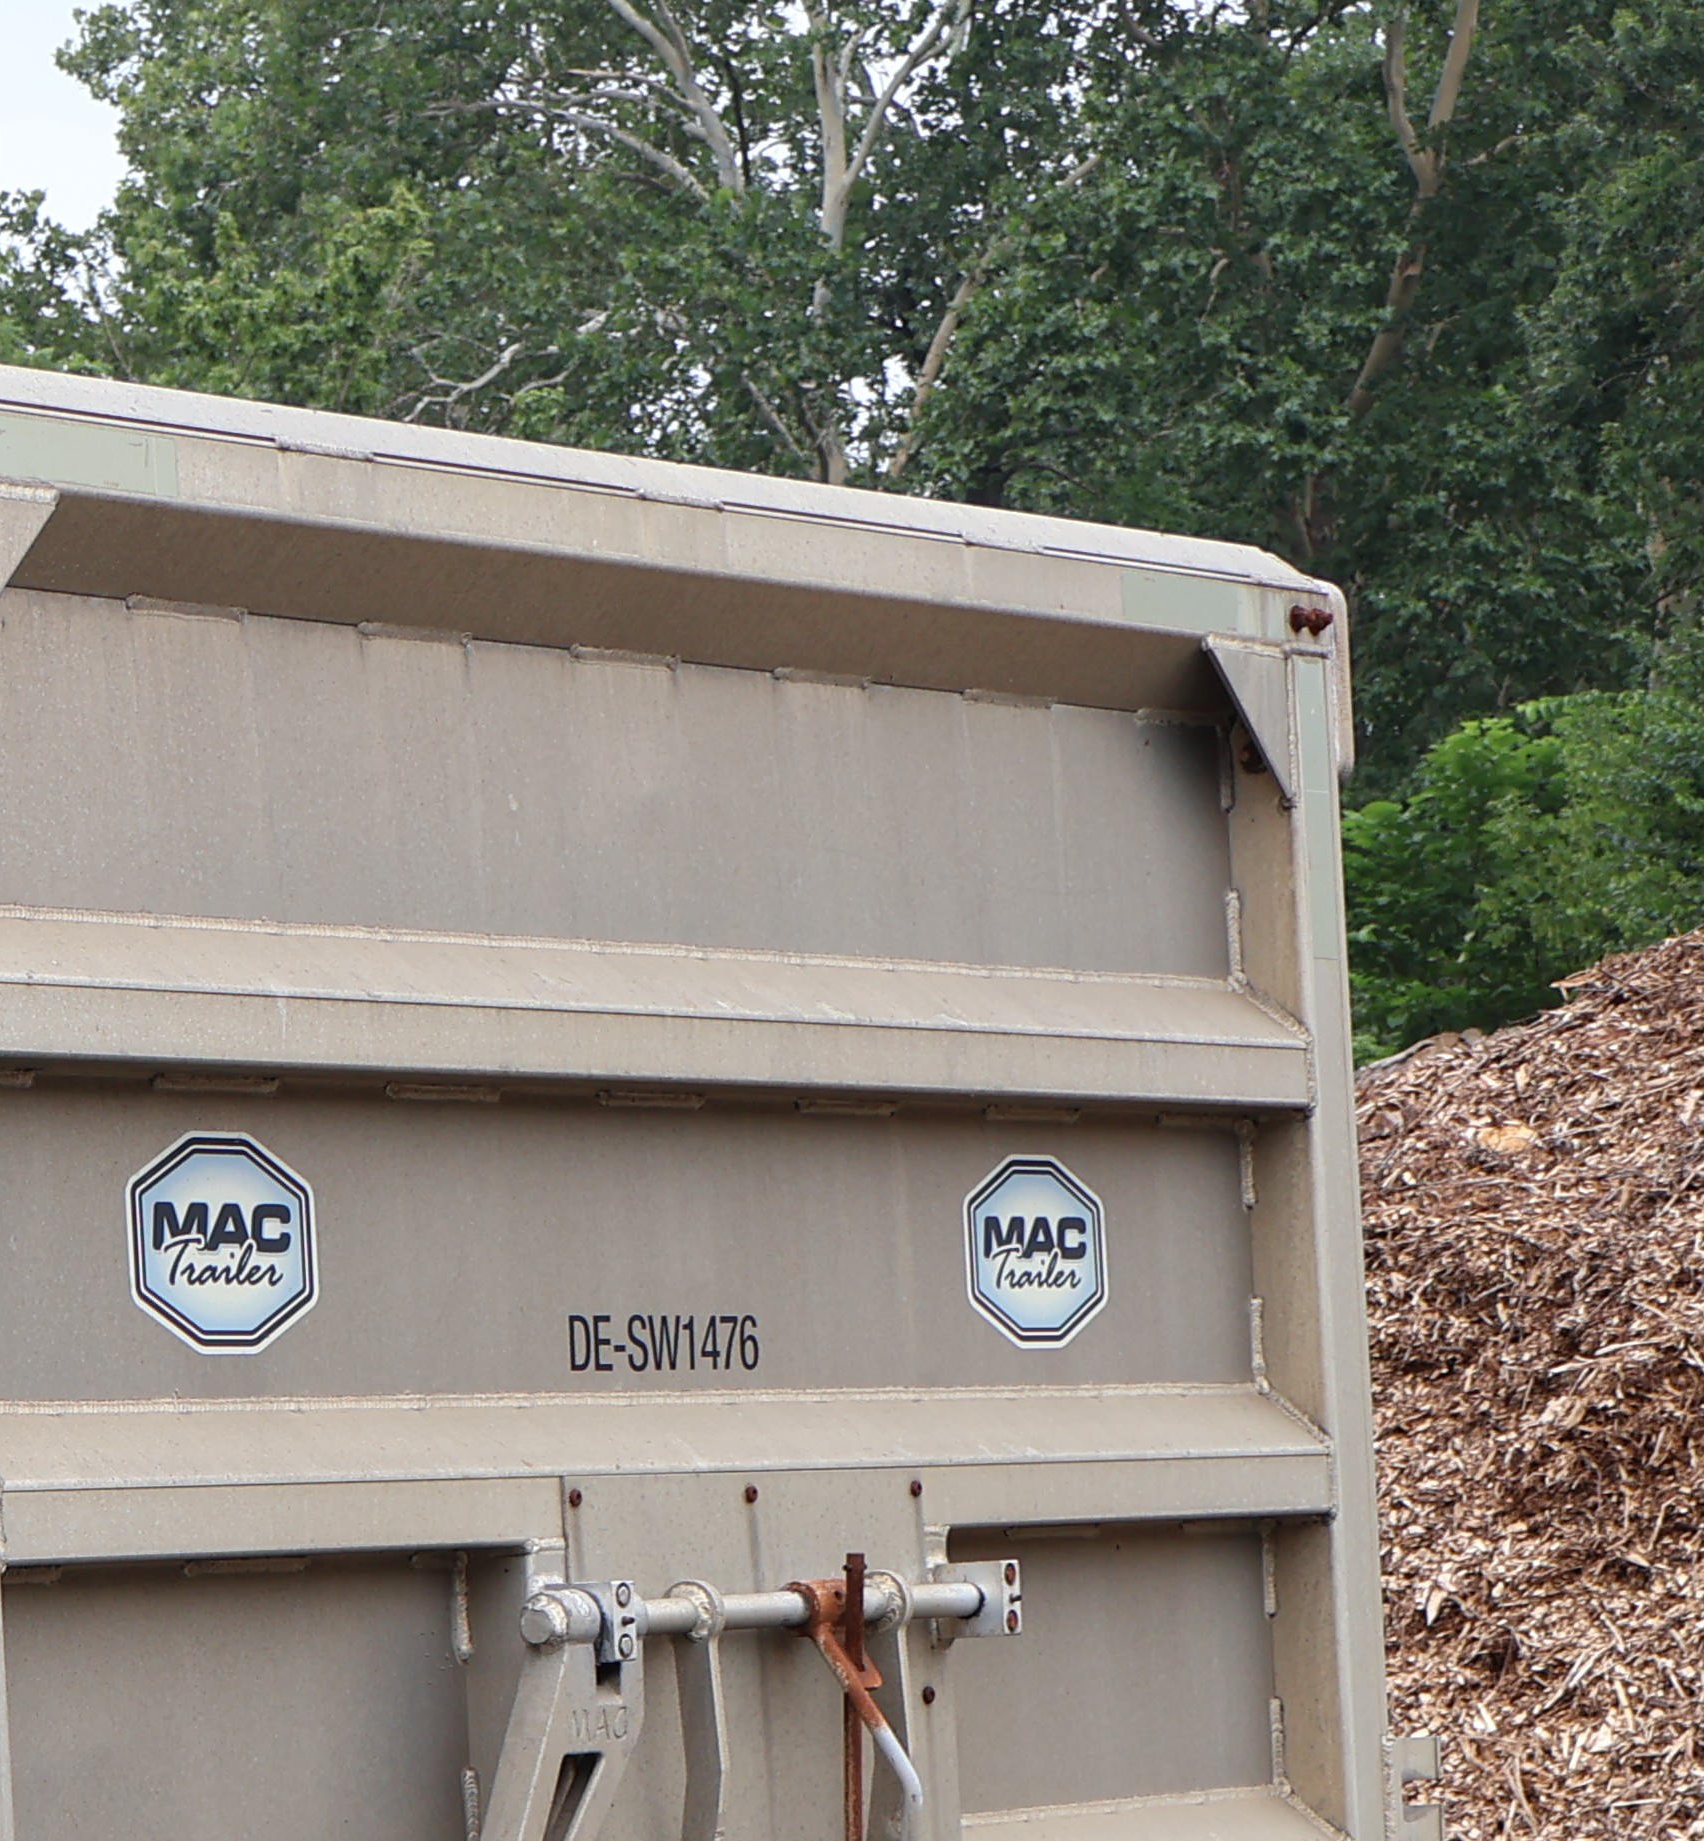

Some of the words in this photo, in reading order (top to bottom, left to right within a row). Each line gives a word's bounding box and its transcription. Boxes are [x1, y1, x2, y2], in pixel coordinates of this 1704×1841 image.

[152, 1201, 292, 1254] MAC
[983, 1215, 1087, 1260] MAC
[163, 1237, 284, 1287] Trailer
[991, 1248, 1082, 1289] Trailer
[568, 1314, 760, 1372] DE-SW1476
